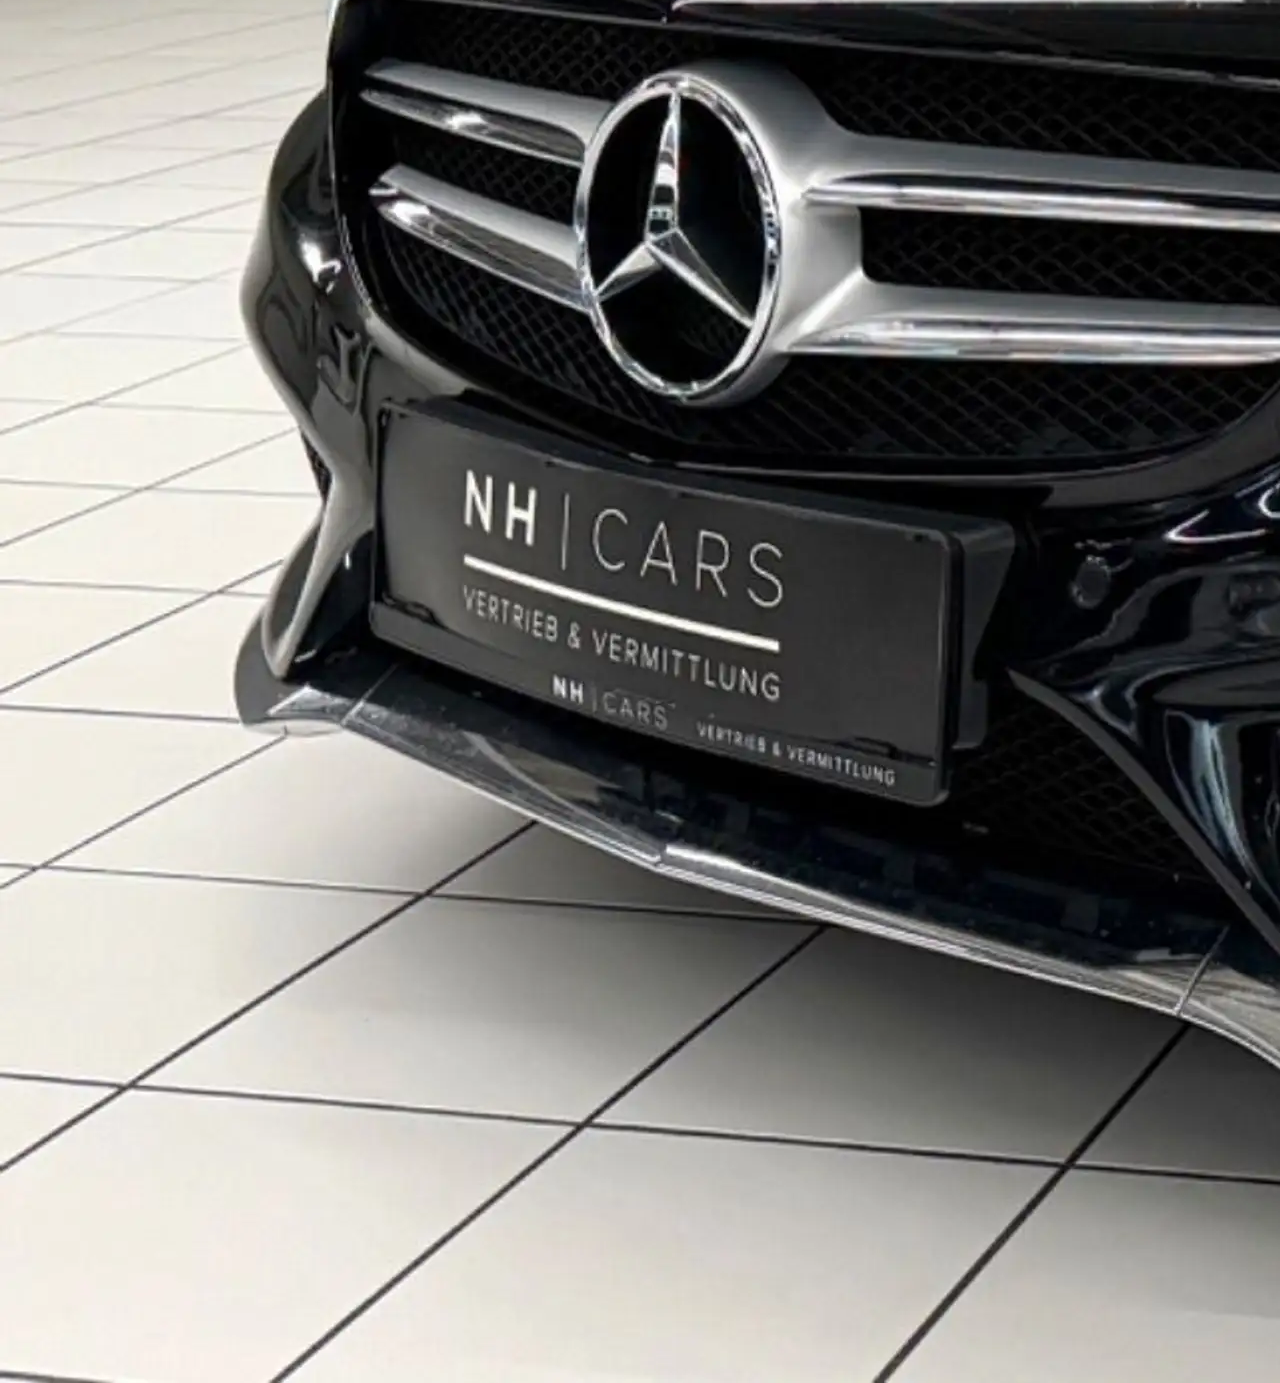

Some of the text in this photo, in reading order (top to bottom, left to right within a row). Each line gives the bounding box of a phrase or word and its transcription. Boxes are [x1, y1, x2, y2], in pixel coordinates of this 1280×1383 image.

[463, 469, 538, 547] NH
[592, 507, 784, 609] CARS
[462, 584, 781, 702] VERTRIEB & VERMITTLUNG
[551, 673, 585, 705] NH
[602, 690, 669, 732] CARS
[697, 720, 896, 787] VERTRIEB & VERMITTLUNG
